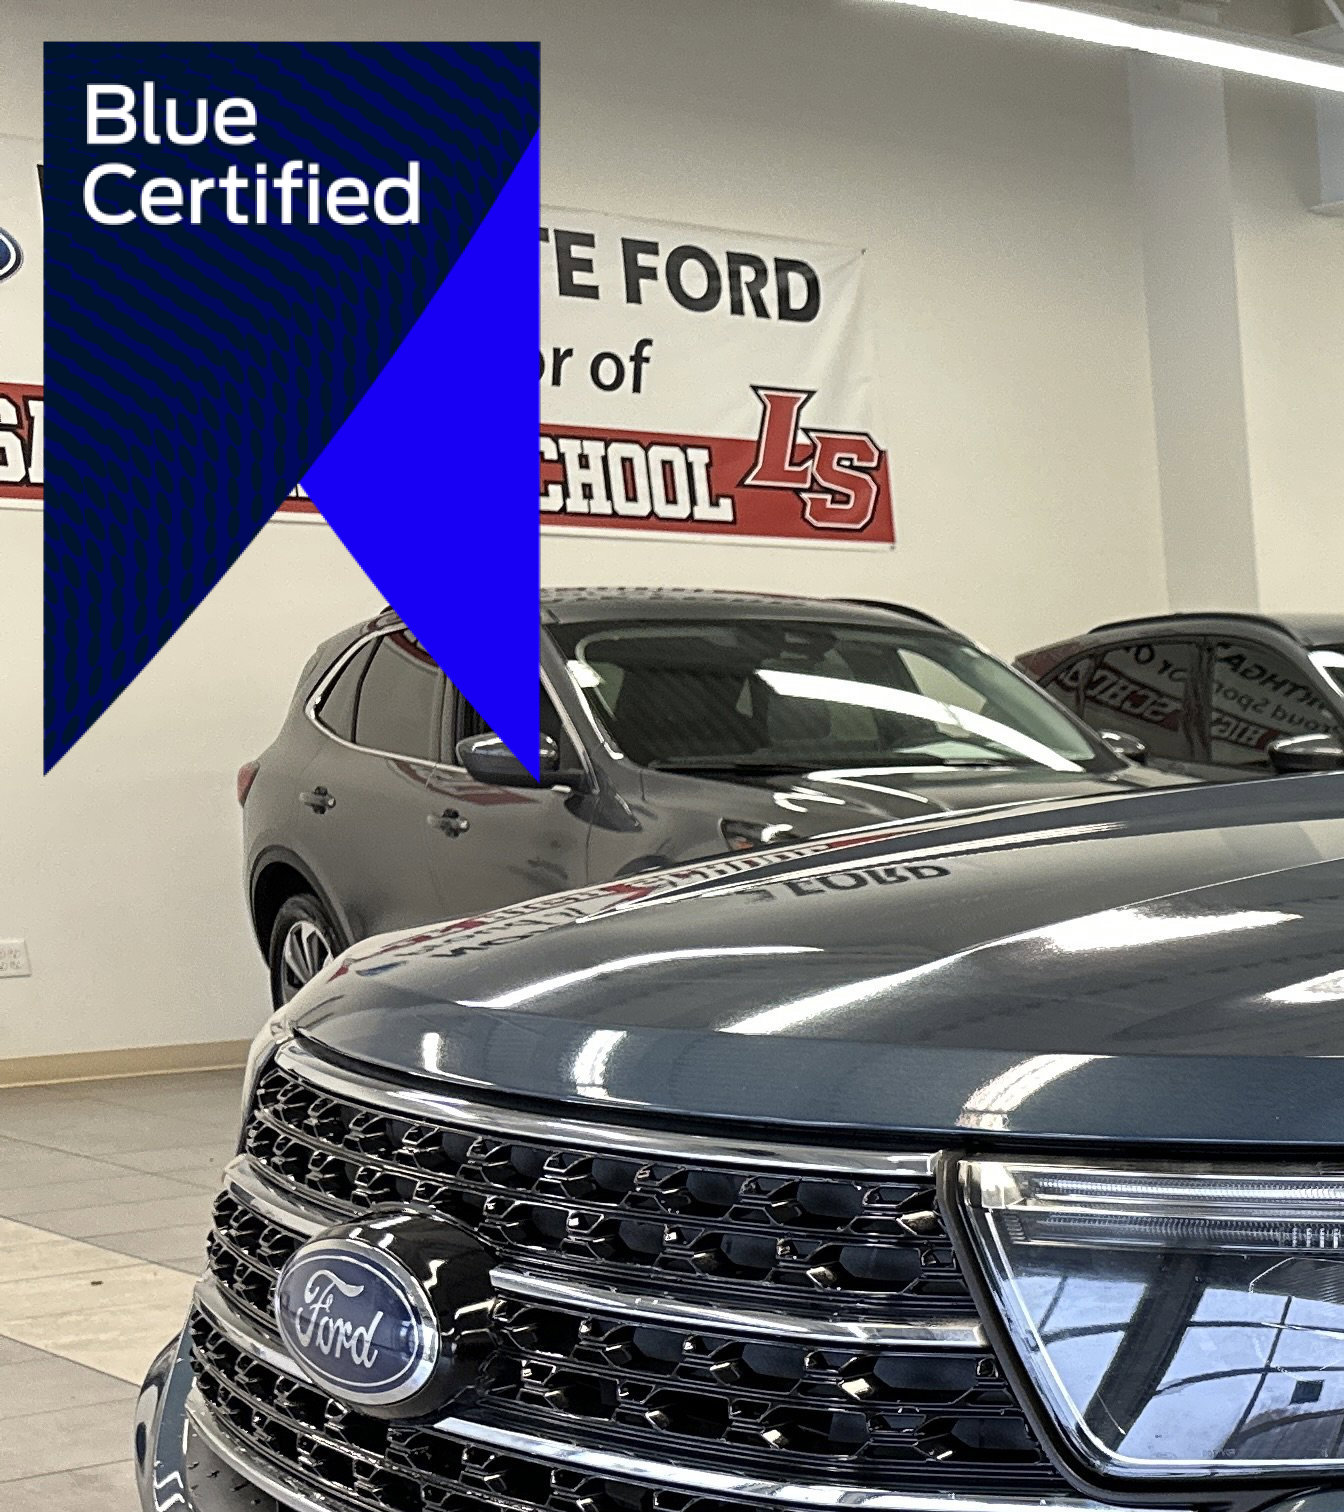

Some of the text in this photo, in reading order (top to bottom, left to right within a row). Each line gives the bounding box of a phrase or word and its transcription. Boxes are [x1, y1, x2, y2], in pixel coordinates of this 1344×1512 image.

[621, 236, 822, 323] FORD
[590, 337, 654, 394] of
[540, 437, 736, 523] CHOOL
[296, 1269, 384, 1369] Ford
